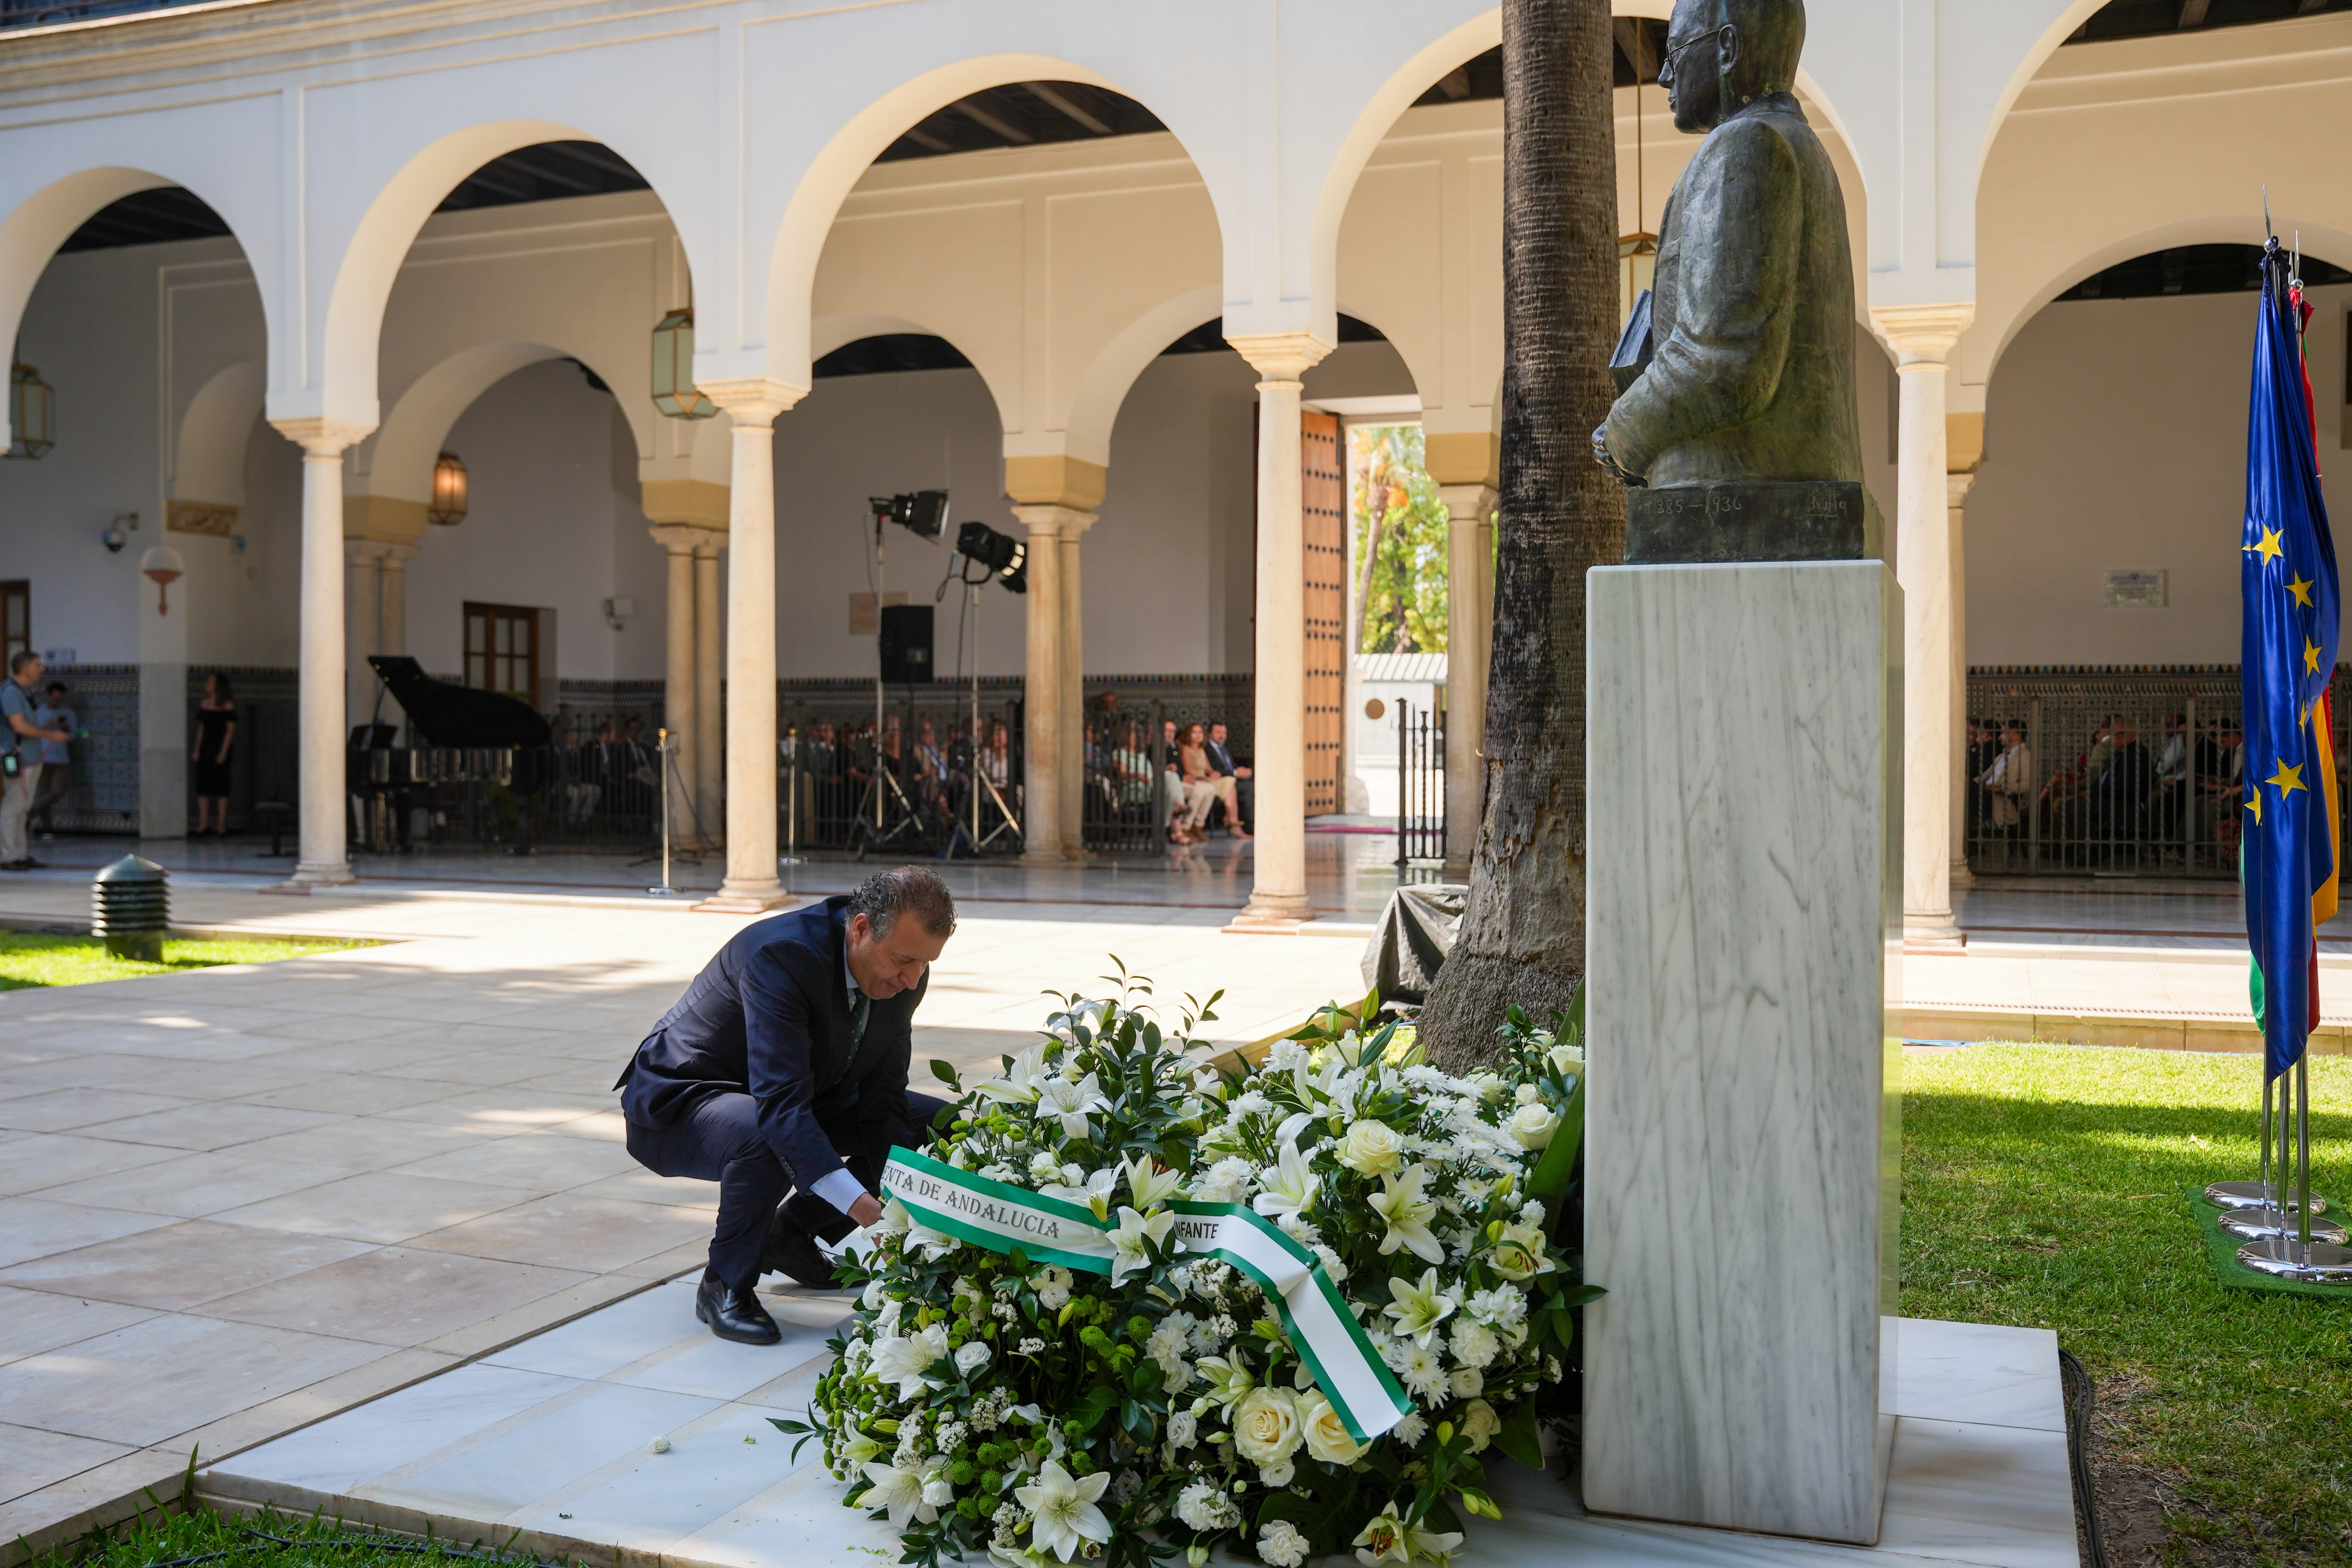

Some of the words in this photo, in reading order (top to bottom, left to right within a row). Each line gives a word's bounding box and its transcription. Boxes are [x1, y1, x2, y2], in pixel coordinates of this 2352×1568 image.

[919, 1179, 942, 1201] DE
[944, 1190, 1060, 1239] ANDALUCIA
[1174, 1221, 1219, 1239] INFANTE
